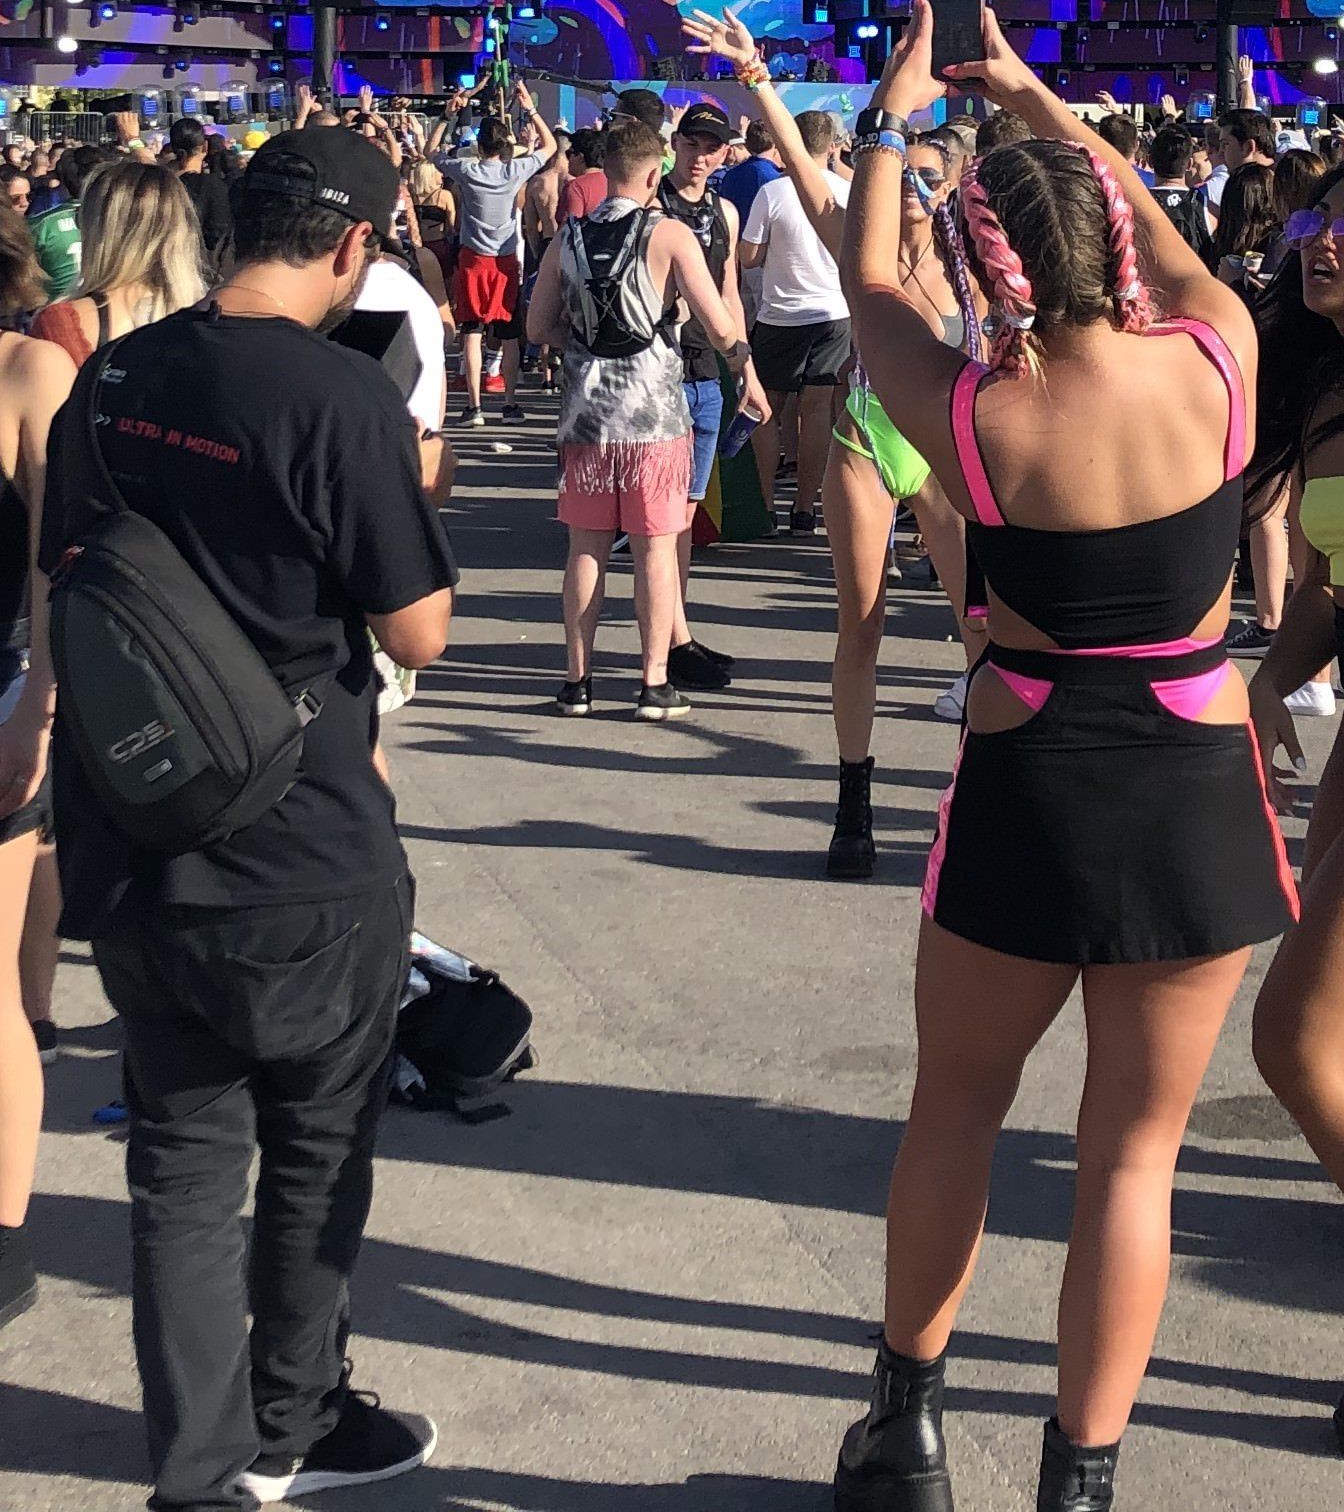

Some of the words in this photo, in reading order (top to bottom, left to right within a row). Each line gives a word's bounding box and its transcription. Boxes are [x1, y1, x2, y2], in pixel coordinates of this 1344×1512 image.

[320, 187, 351, 205] IBIZA
[117, 417, 162, 440] ULTRA
[166, 429, 182, 446] IN
[185, 434, 241, 465] MOTION
